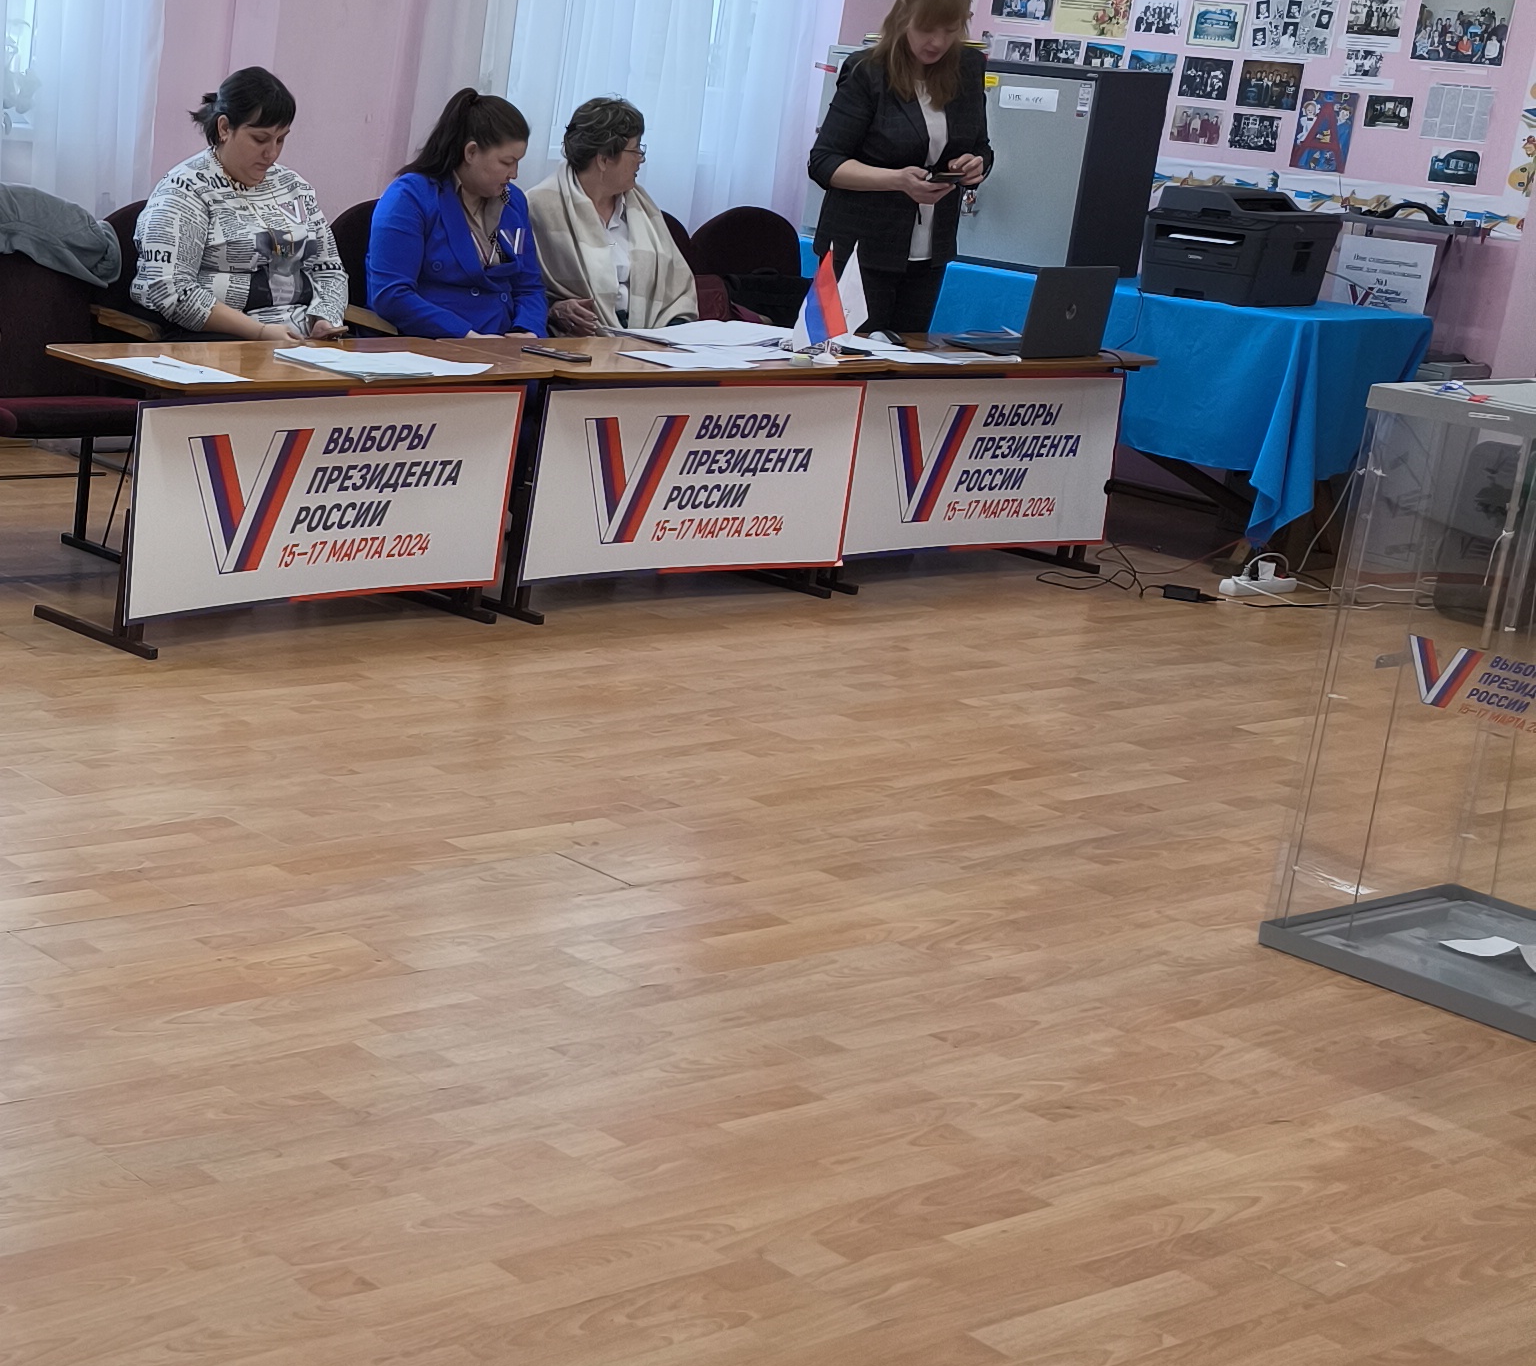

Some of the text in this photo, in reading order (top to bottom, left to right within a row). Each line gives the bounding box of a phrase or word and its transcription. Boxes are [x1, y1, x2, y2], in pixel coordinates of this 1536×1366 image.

[695, 414, 791, 440] ВЫБОРЫ
[983, 403, 1063, 427] ВЫБОРЫ
[322, 423, 437, 455] ВЫБОРЫ
[968, 435, 1081, 462] ПРЕЗИДЕНТА
[679, 448, 813, 477] ПРЕЗИДЕНТА
[306, 459, 463, 495] ПРЕЗИДЕНТА
[953, 468, 1029, 492] РОССИИ
[663, 483, 751, 510] РОССИИ
[978, 498, 1024, 519] МАРТА
[1022, 497, 1056, 517] 2024
[290, 500, 392, 534] РОССИИ
[692, 516, 746, 539] МАРТА
[744, 515, 784, 538] 2024
[325, 536, 387, 563] МАРТА
[385, 533, 431, 559] 2024
[1489, 656, 1536, 677] ВЫБО
[1466, 688, 1531, 714] РОССИИ
[1487, 712, 1526, 730] МАРТА
